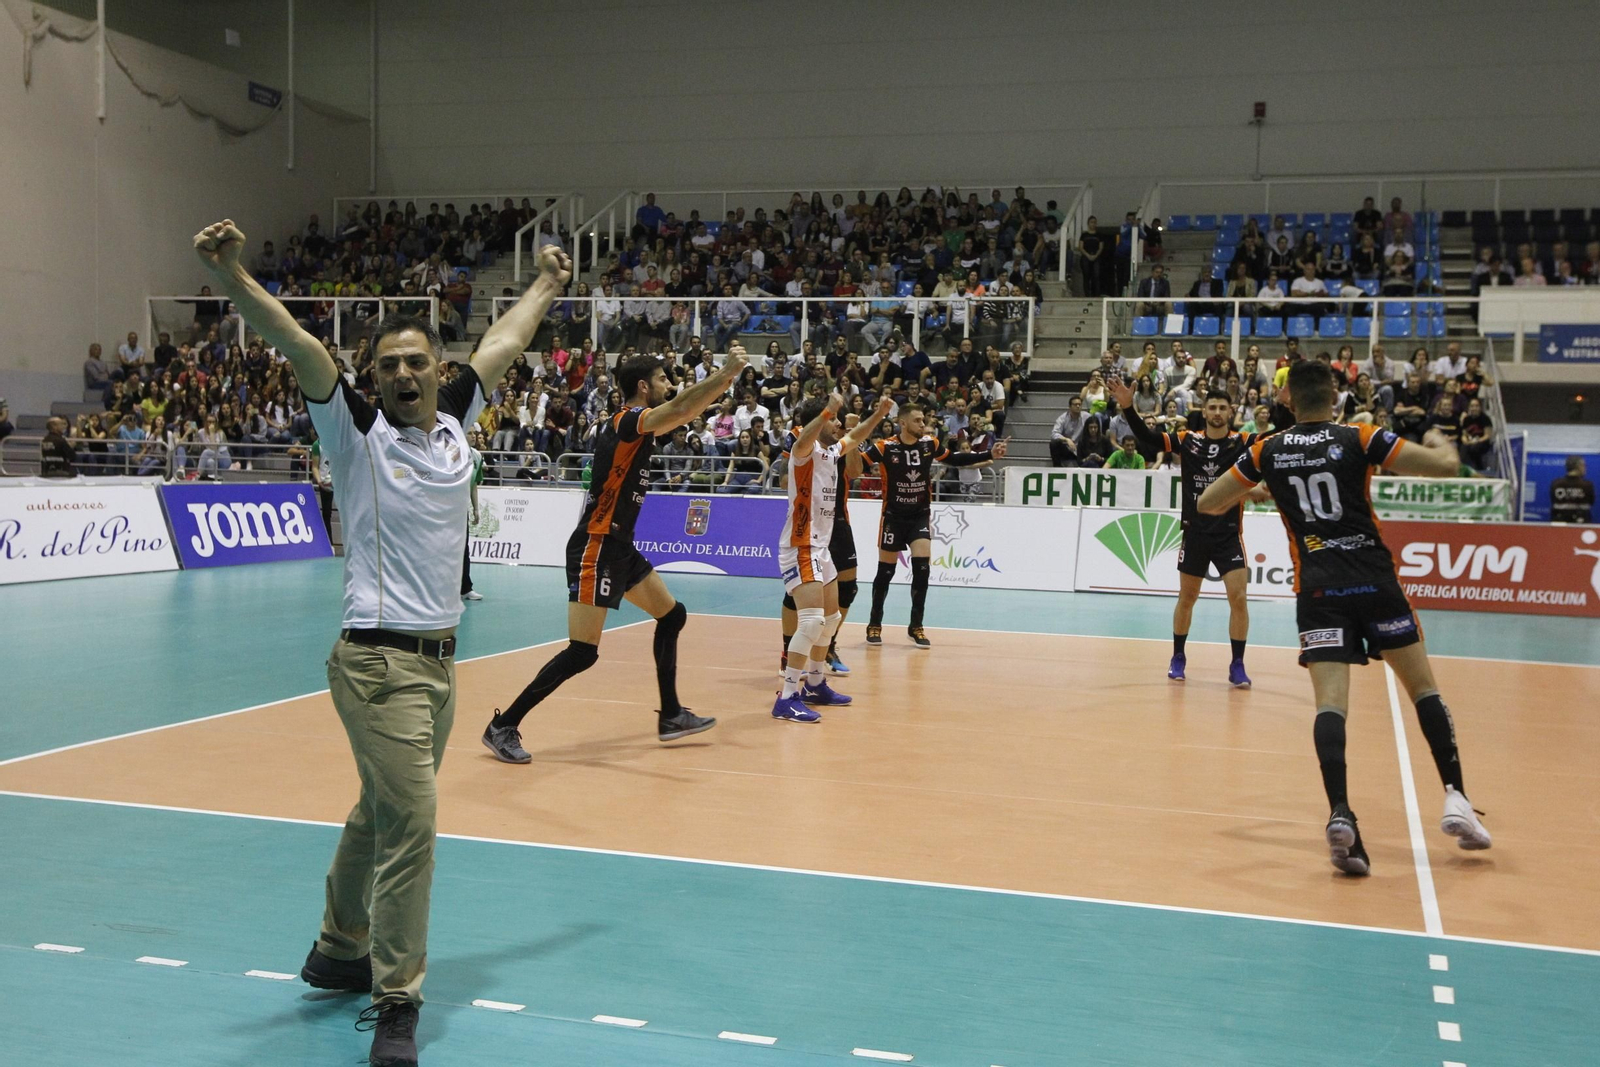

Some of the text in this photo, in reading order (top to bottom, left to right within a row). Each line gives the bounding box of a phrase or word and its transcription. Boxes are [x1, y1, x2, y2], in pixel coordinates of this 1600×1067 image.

[904, 450, 920, 466] 13
[1207, 444, 1220, 458] 9
[1273, 453, 1305, 461] Talleres
[896, 495, 918, 503] Teruel
[1288, 472, 1343, 522] 10
[1378, 482, 1492, 503] CAMPEON
[26, 499, 106, 512] autocares
[41, 521, 96, 558] del
[96, 515, 169, 554] Pino
[884, 532, 894, 545] 13
[696, 544, 712, 555] DE
[715, 544, 772, 558] ALMERÍA
[1398, 542, 1528, 582] SVM
[600, 578, 611, 596] 6
[1404, 584, 1586, 606] UPERLIGA VOLEIBOL MASCULINA
